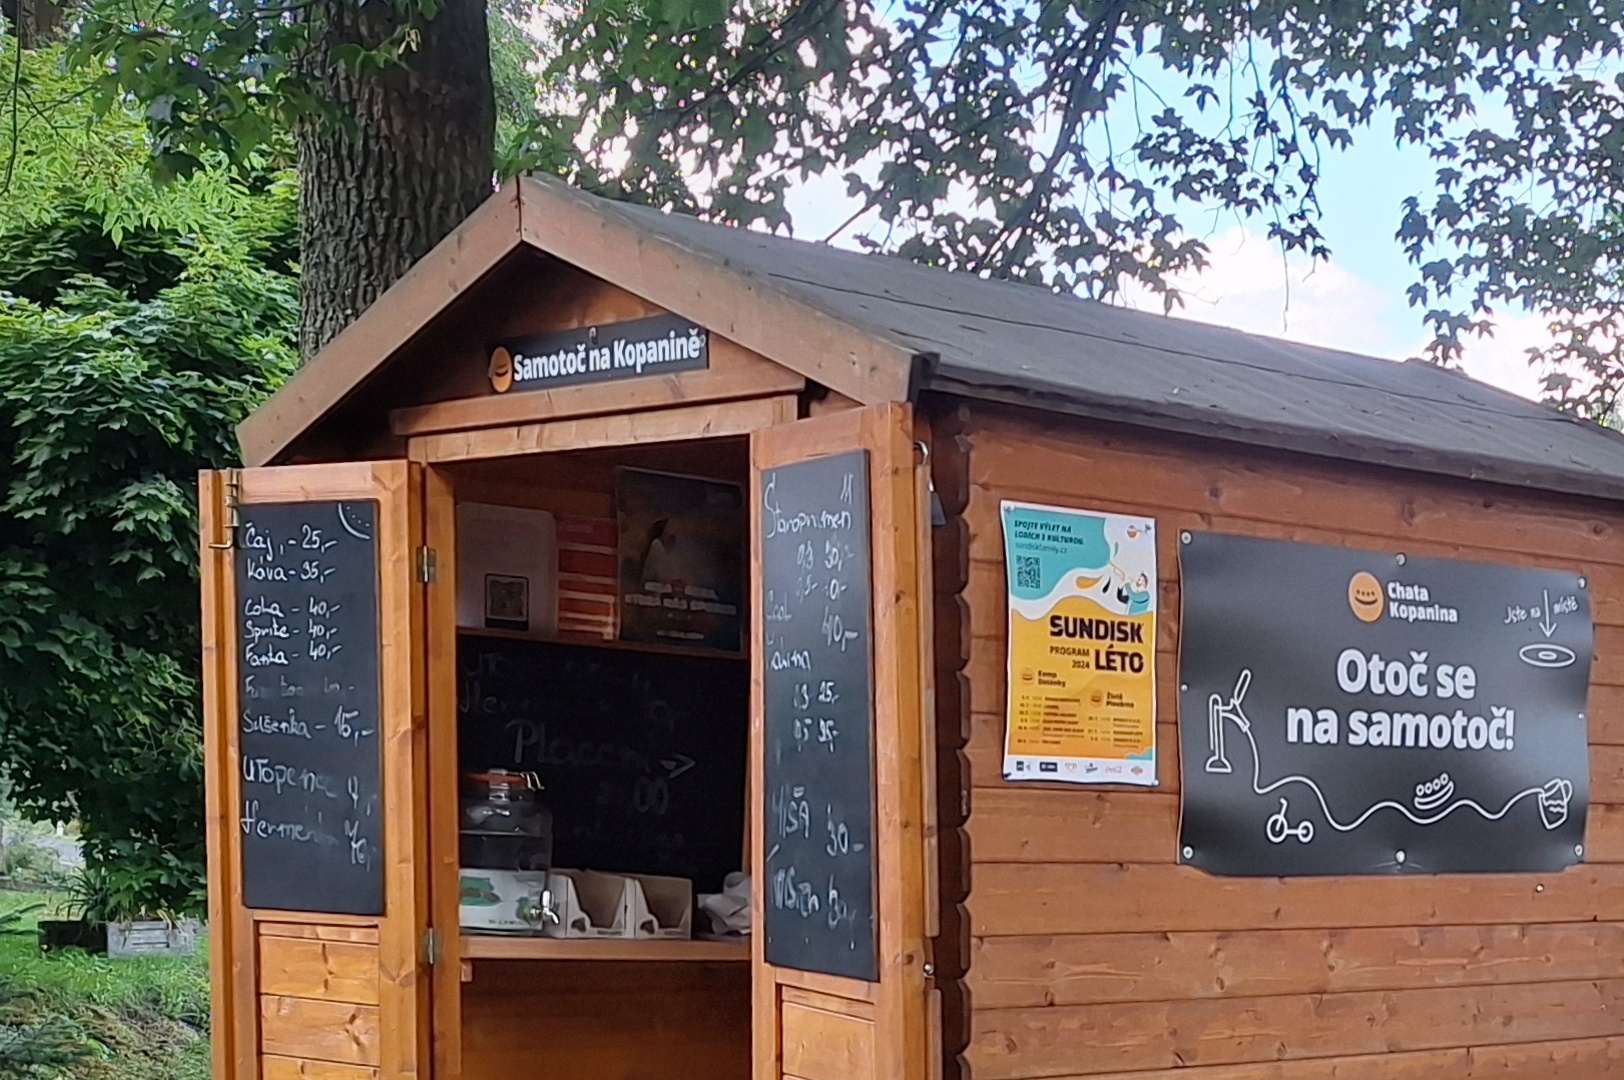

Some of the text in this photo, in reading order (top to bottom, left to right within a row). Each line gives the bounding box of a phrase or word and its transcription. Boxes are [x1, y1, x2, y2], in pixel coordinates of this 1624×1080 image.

[513, 328, 700, 381] Samotoč na Kopanině
[245, 522, 273, 562] Čaj
[247, 555, 288, 581] Káva
[1388, 582, 1429, 602] Chata
[1389, 601, 1458, 623] Kopanina
[1504, 595, 1578, 624] Jste na místě
[243, 617, 290, 644] Sprite
[1049, 614, 1144, 645] SUNDISK
[245, 642, 289, 667] Fanta
[1049, 645, 1090, 657] PROGRAM
[1071, 659, 1090, 670] 2024
[1094, 643, 1145, 673] LÉTO
[1336, 649, 1477, 699] Otoč se
[1286, 706, 1516, 751] na samotoč!
